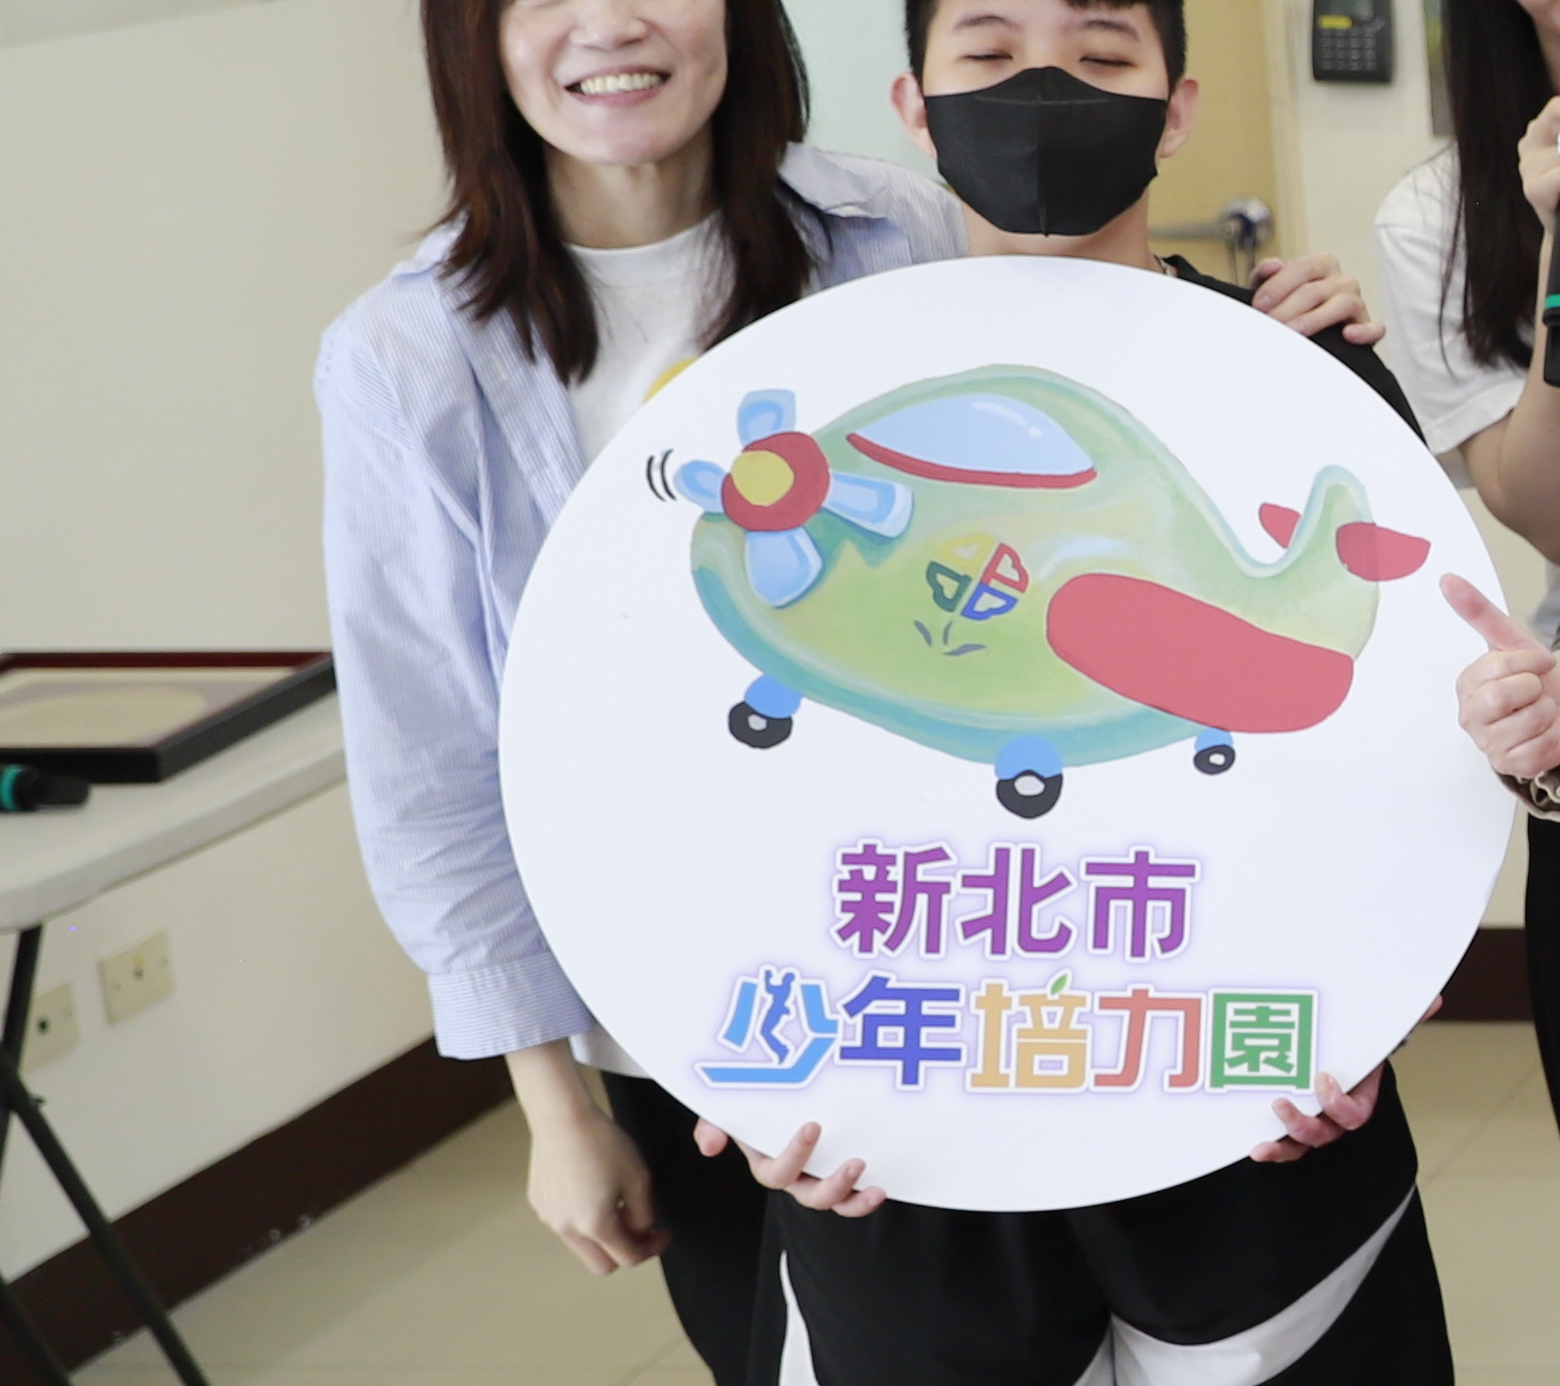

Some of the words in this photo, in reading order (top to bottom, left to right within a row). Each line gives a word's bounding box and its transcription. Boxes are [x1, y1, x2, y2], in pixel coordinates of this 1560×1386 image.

[836, 844, 1197, 957] 新北市
[697, 968, 1315, 1091] 少年培力園
